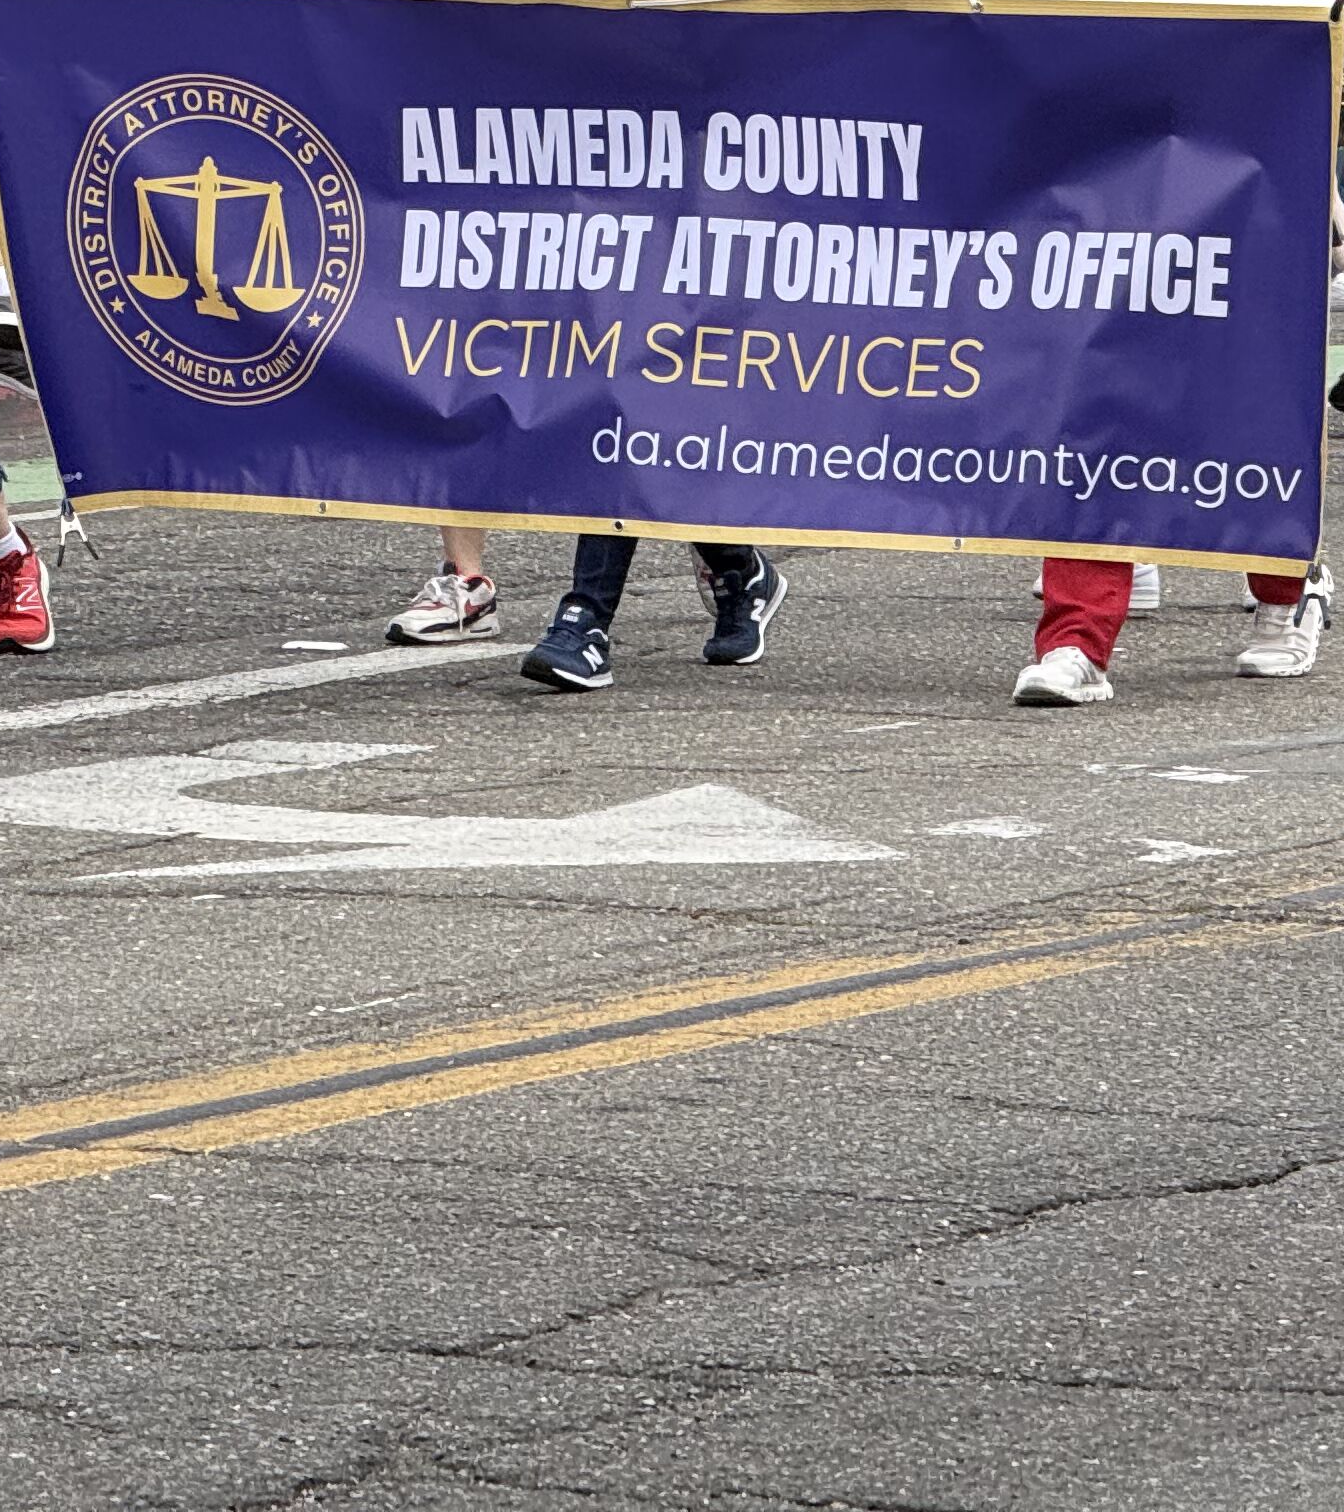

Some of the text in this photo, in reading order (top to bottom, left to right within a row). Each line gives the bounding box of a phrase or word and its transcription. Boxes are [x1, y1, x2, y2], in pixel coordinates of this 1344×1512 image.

[82, 88, 350, 305] DISTRICT ATTORNEY'S OFFICE
[401, 107, 923, 202] ALAMEDA COUNTY
[399, 208, 1232, 319] DISTRICT ATTORNEY'S OFFICE
[134, 328, 302, 388] ALAMEDA COUNTY
[395, 315, 986, 400] VICTIM SERVICES
[592, 415, 1304, 511] da.alamedacountyca.gov
